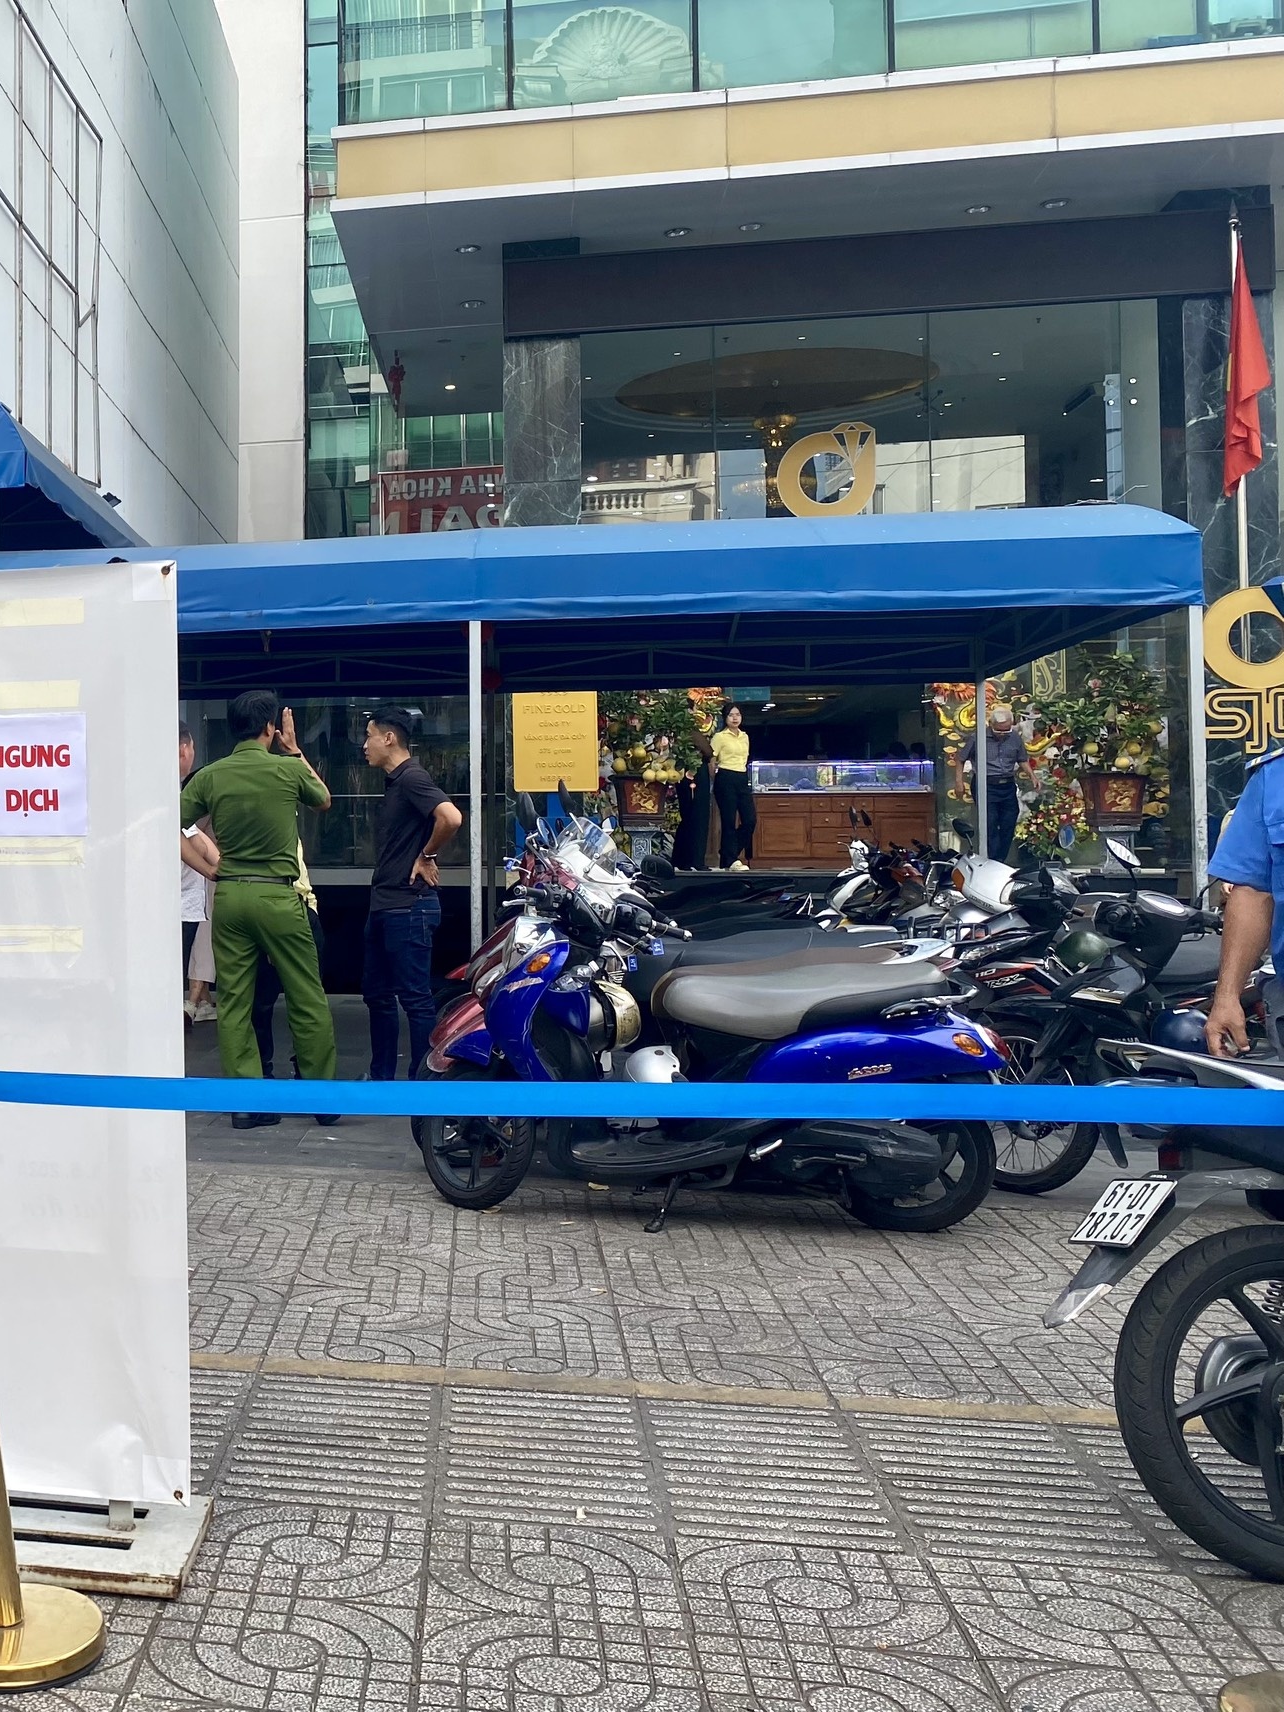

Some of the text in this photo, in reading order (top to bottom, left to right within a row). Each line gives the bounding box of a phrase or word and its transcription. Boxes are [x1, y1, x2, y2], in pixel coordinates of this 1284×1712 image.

[523, 703, 587, 714] FINE GOLD
[6, 789, 59, 818] DỊCH
